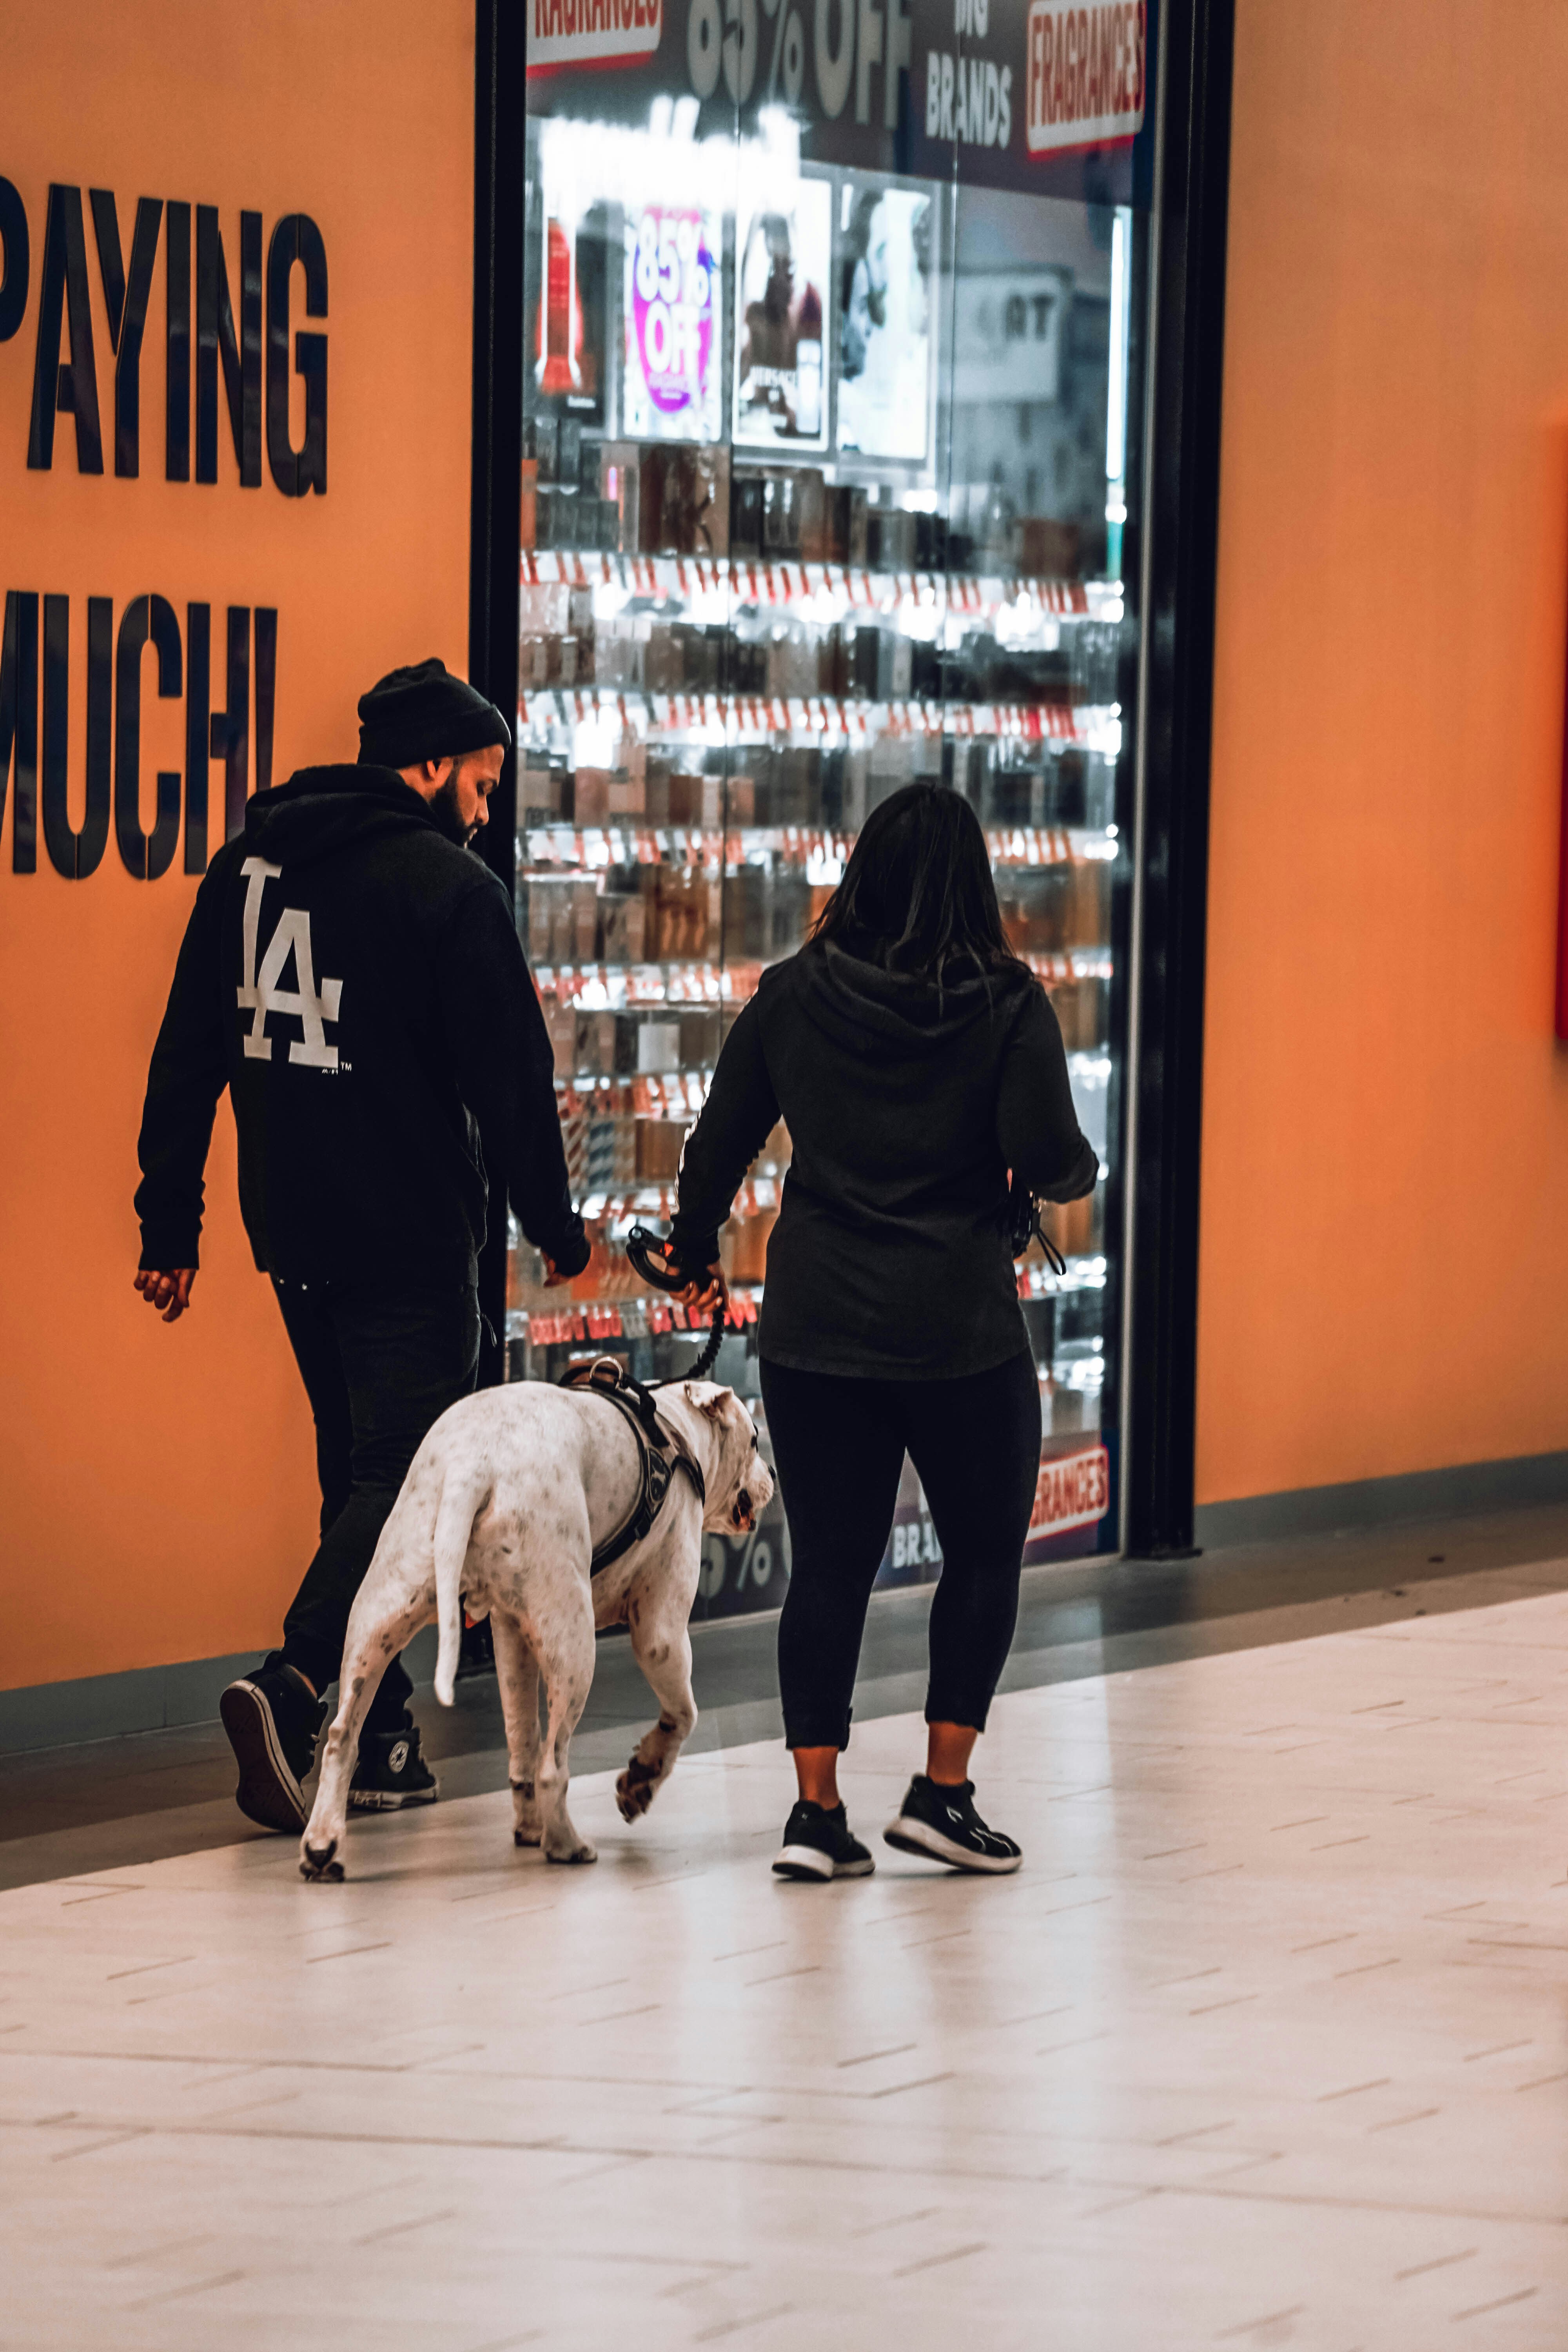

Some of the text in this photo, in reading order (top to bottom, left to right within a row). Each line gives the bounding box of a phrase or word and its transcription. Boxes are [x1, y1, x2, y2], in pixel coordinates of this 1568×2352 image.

[926, 51, 1012, 149] BRANDS
[1031, 2, 1144, 127] FRAGRANCES
[636, 214, 709, 307] 85%
[645, 300, 701, 374] OFF
[237, 856, 343, 1069] LA
